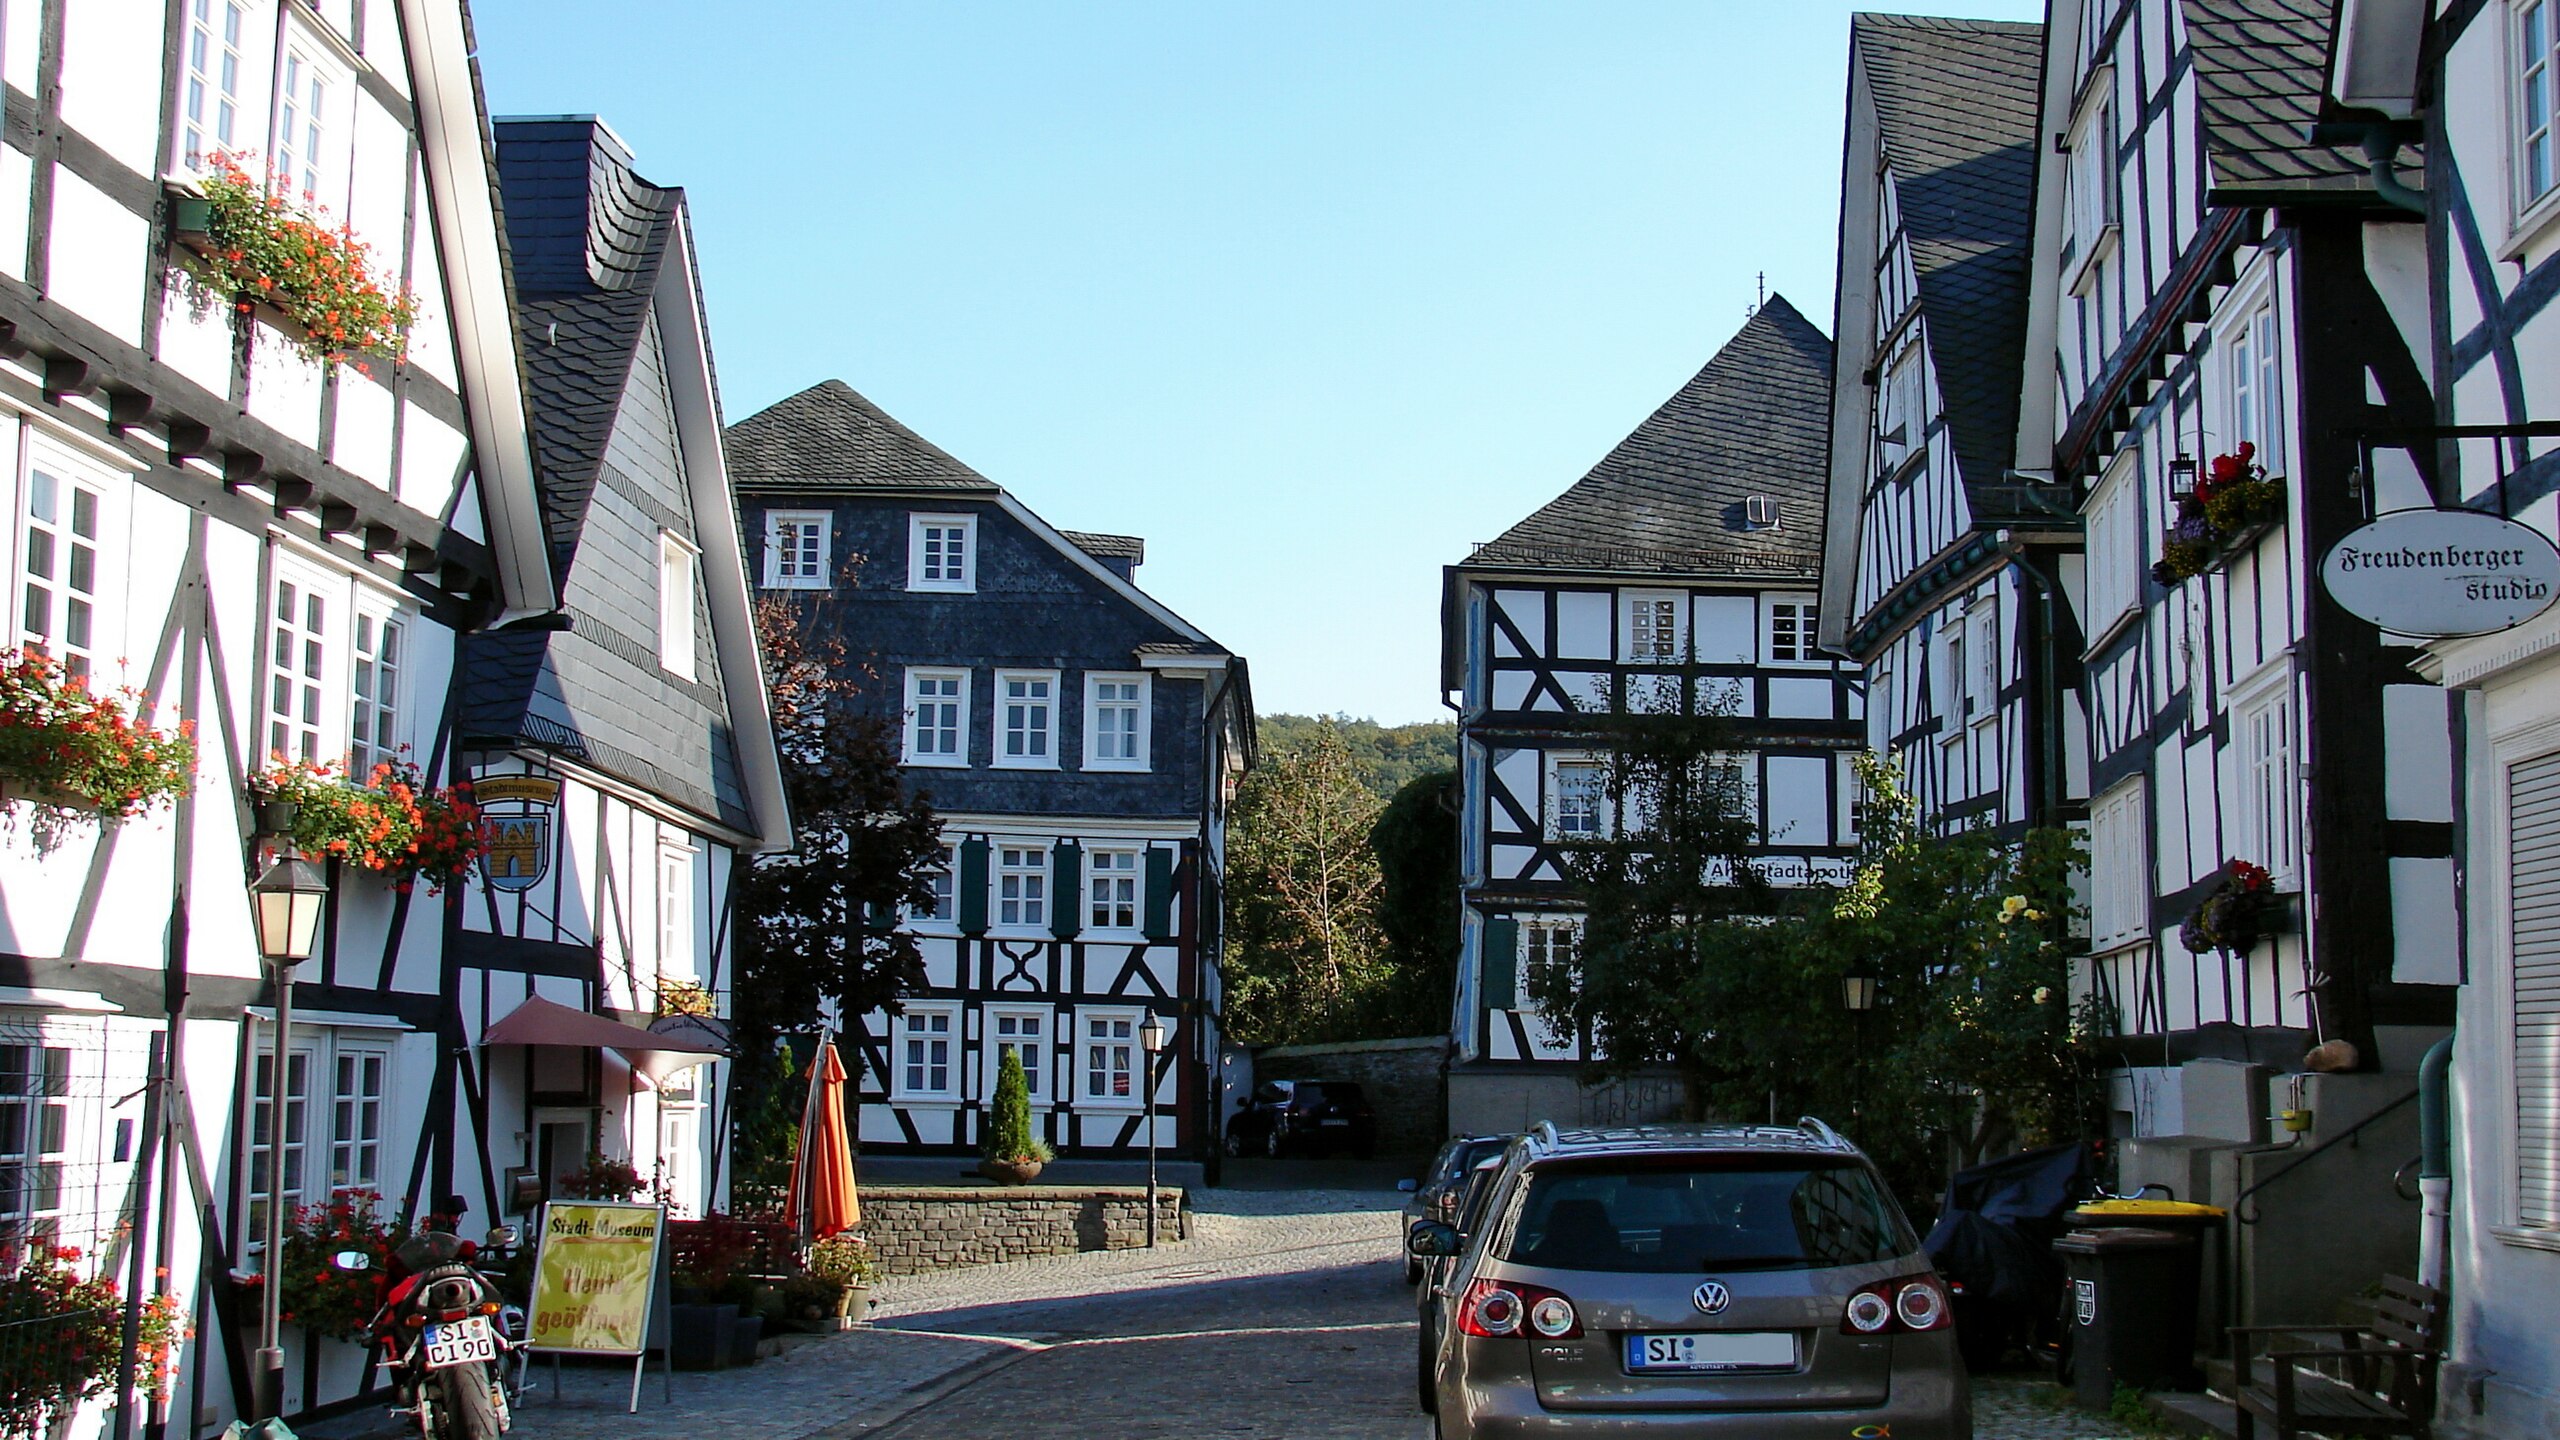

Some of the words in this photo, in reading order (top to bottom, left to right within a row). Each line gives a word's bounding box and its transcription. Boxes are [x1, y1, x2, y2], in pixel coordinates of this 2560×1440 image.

[2339, 546, 2524, 572] Freudenberger
[551, 1217, 654, 1238] Stadt-Museum
[563, 1266, 625, 1295] Heute
[440, 1322, 469, 1342] SI
[1648, 1338, 1680, 1362] SI
